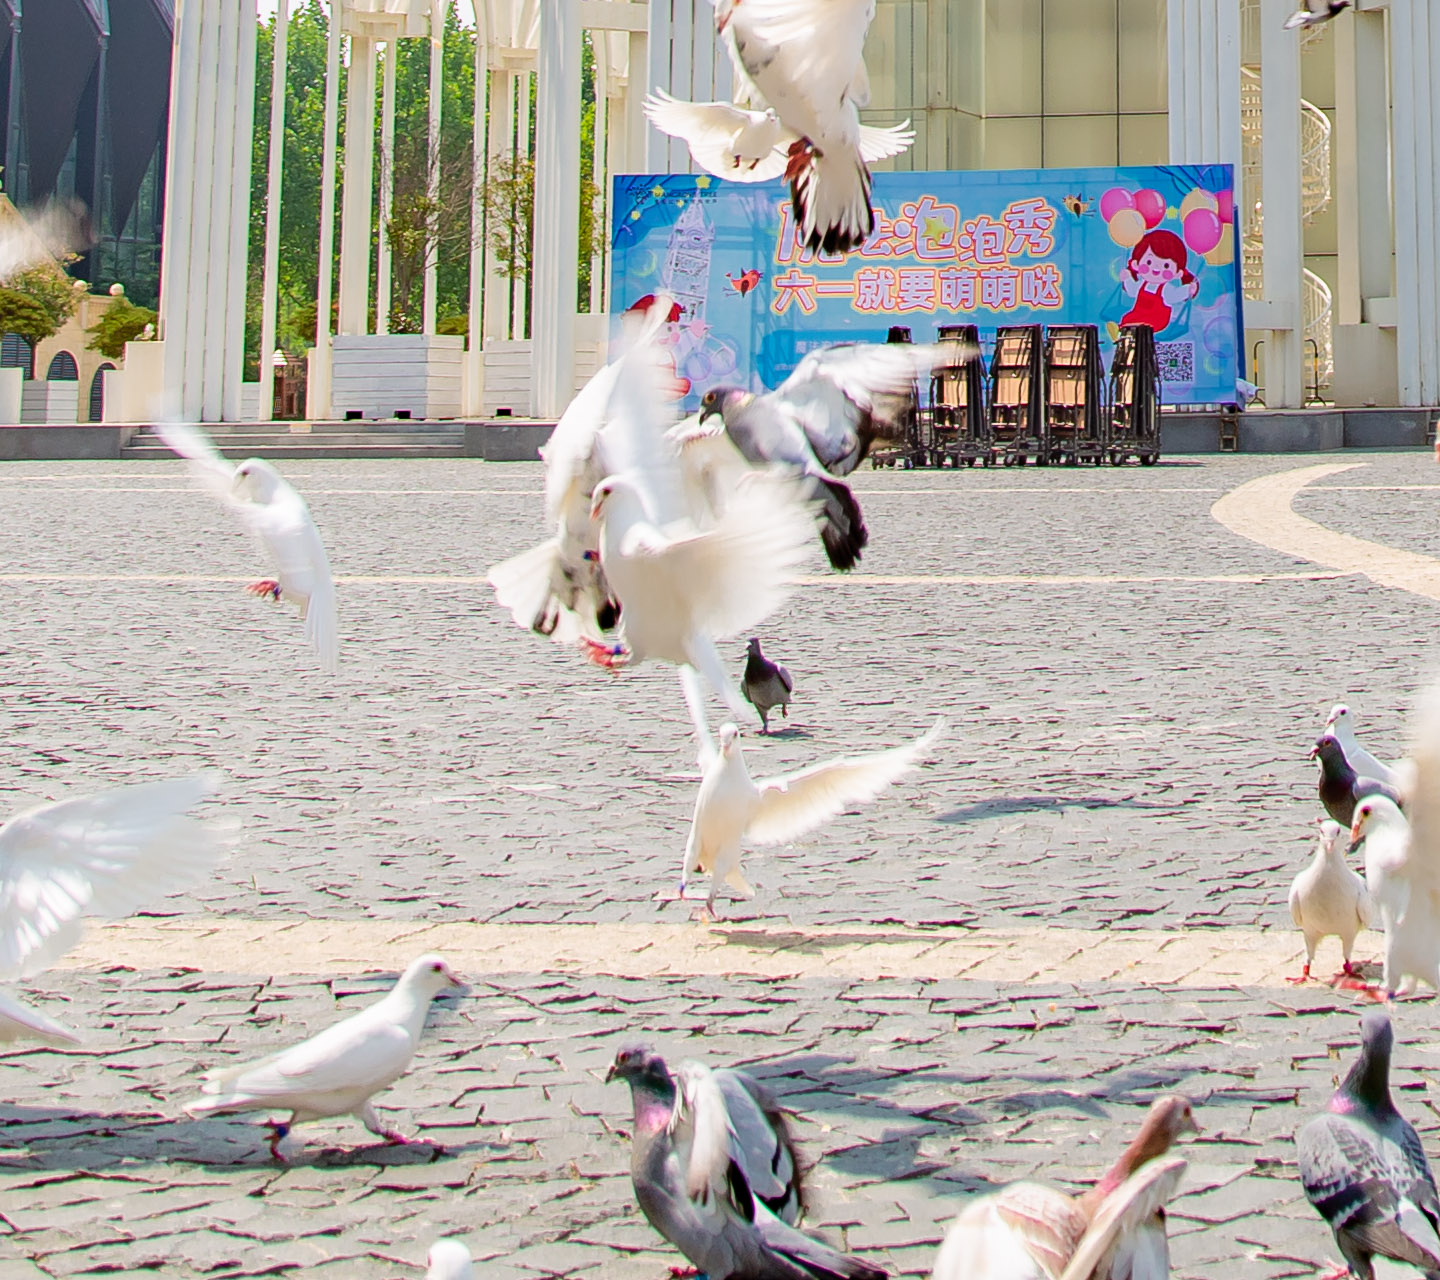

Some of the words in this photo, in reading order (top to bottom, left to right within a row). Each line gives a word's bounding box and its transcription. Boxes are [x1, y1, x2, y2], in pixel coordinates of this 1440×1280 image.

[773, 266, 1061, 313] 六一就要萌萌哒
